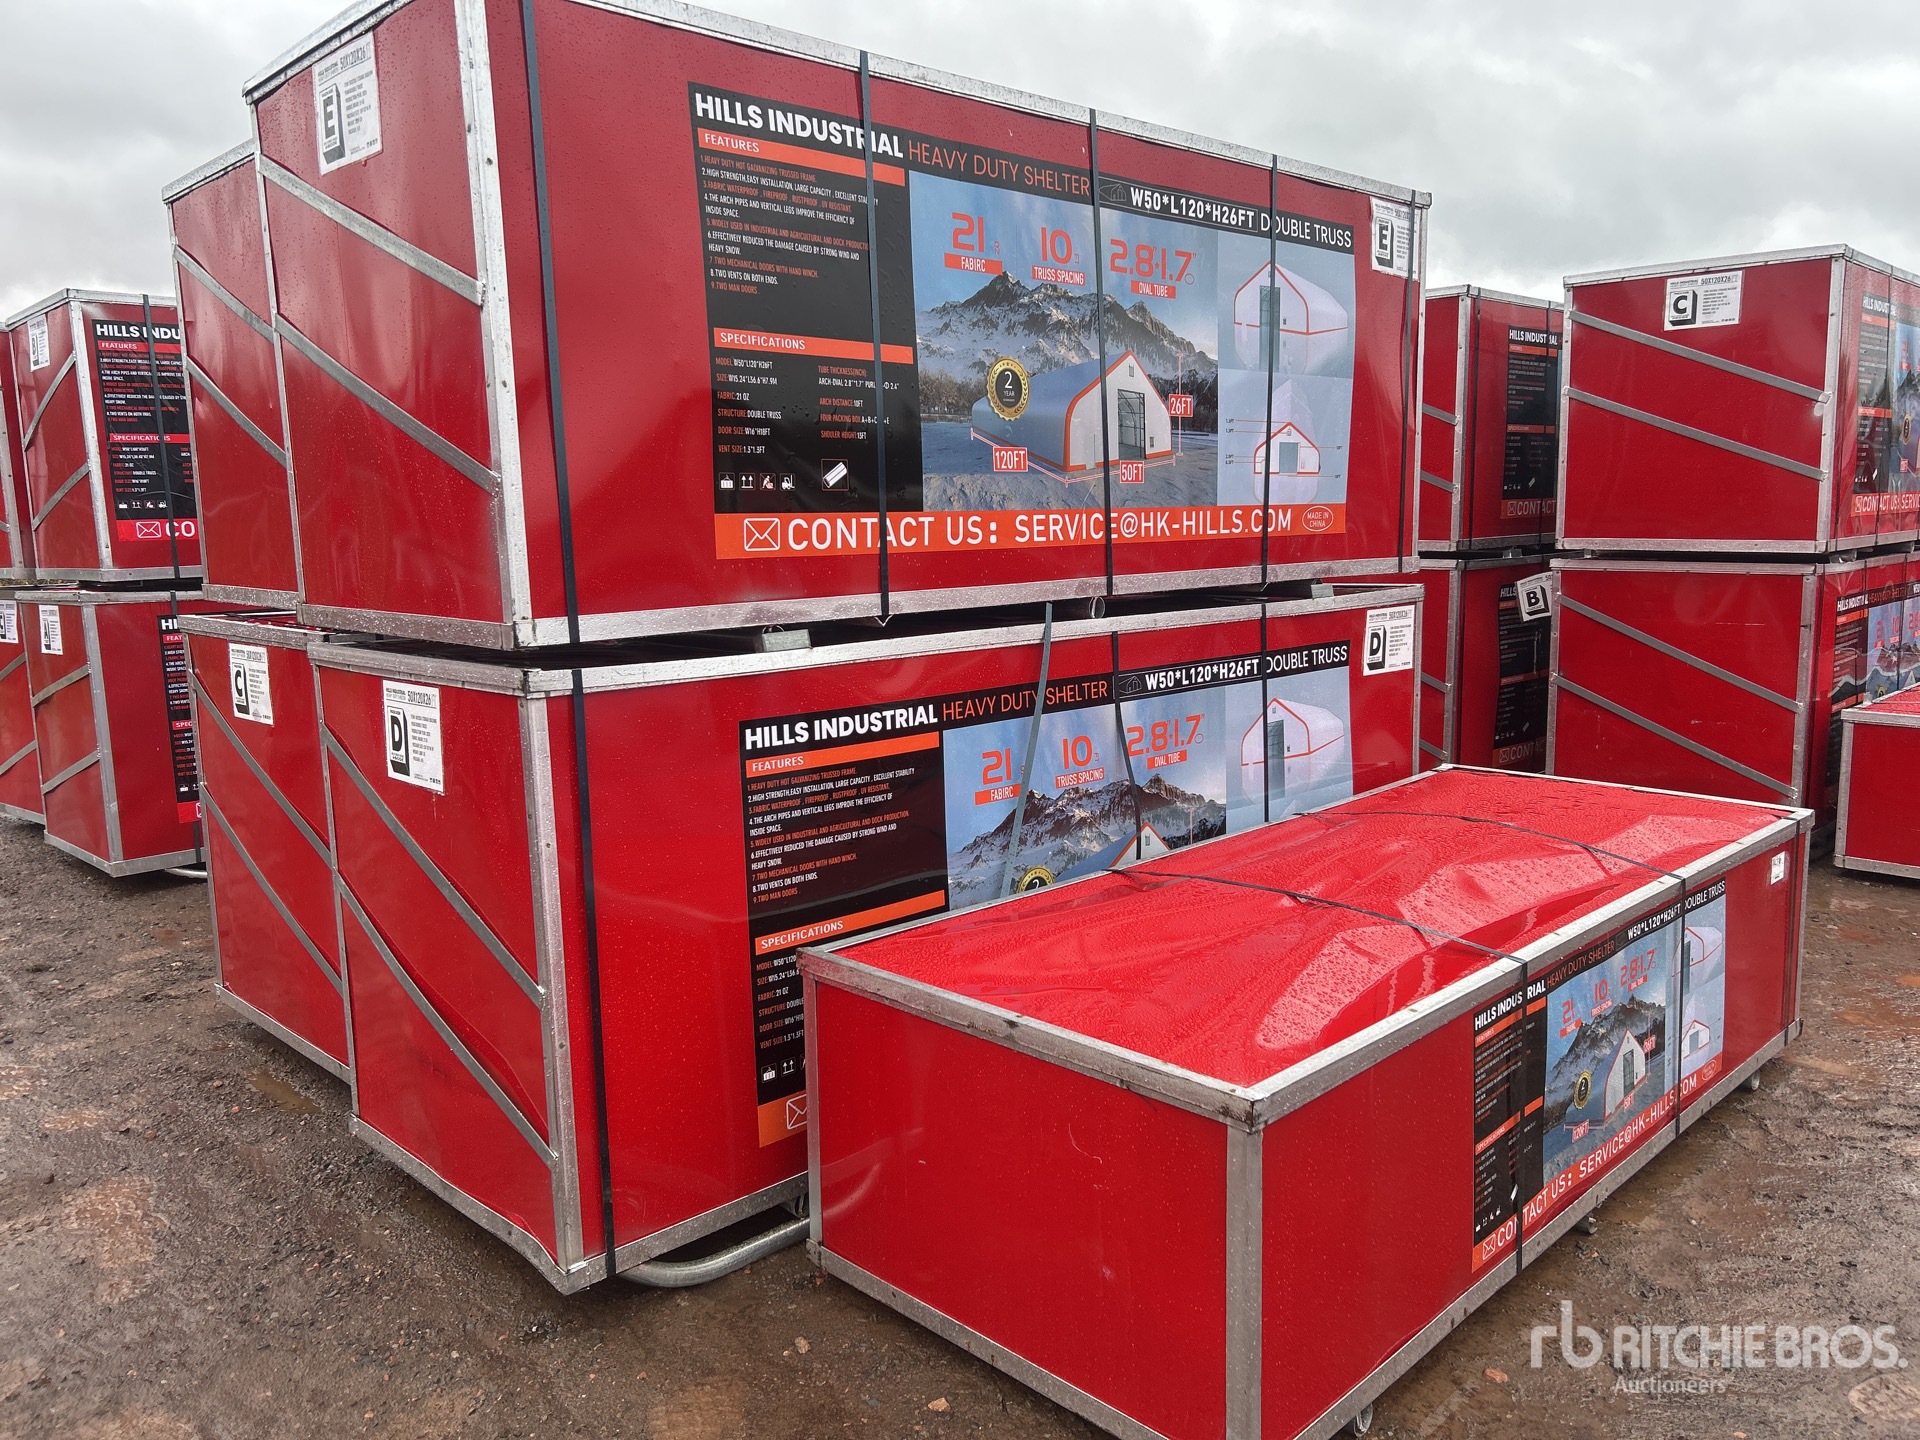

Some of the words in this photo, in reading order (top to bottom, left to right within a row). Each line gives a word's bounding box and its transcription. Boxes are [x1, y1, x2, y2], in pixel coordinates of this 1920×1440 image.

[323, 95, 336, 140] E
[704, 132, 760, 153] FEATURES
[695, 92, 764, 130] HILLS
[768, 108, 904, 159] INDUSTRIAL
[908, 140, 968, 171] HEAVY
[974, 154, 1018, 182] DUTY
[1024, 166, 1090, 196] SHELTER
[1314, 224, 1352, 248] TRUSS
[701, 165, 718, 177] 2.HIGH
[794, 183, 808, 193] LARGE
[834, 190, 856, 202] EXCELLENT
[703, 191, 718, 202] 4.THE
[719, 194, 733, 204] ARCH
[734, 197, 748, 207] PIPES
[749, 199, 759, 209] AND
[760, 201, 782, 213] VERTICAL
[783, 205, 794, 215] LEGS
[795, 207, 815, 218] IMPROVE
[815, 210, 824, 220] THE
[825, 212, 848, 224] EFFICIENCY
[705, 204, 721, 215] INSIDE
[952, 212, 985, 252] 21
[1378, 224, 1388, 251] E
[708, 242, 723, 252] HEAVY
[742, 235, 764, 246] REDUCED
[765, 238, 774, 247] THE
[774, 240, 794, 250] DAMAGE
[794, 243, 812, 253] CAUSED
[820, 247, 837, 256] STRONG
[838, 249, 849, 258] WIND
[850, 251, 859, 260] AND
[1041, 227, 1072, 264] 10
[709, 267, 726, 278] 8.TWO
[727, 270, 742, 280] VENTS
[751, 273, 764, 282] BOTH
[961, 257, 986, 272] FABIRC
[1034, 266, 1056, 282] TRUSS
[1057, 270, 1084, 284] SPACING
[1138, 282, 1152, 296] OVAL
[1154, 284, 1168, 298] TUBE
[1673, 295, 1688, 314] C
[96, 324, 140, 338] HILLS
[720, 332, 806, 350] SPECIFICATIONS
[1509, 329, 1524, 341] HILLS
[102, 342, 137, 350] FEATURES
[1004, 371, 1013, 388] 2
[1003, 390, 1015, 398] YEAR
[765, 410, 781, 419] TRUSS
[1170, 396, 1192, 416] 26FT
[995, 449, 1026, 470] 120FT
[1121, 464, 1144, 480] 50FT
[1306, 512, 1322, 520] MADE
[1322, 512, 1329, 520] IN
[1309, 519, 1326, 528] CHINA
[788, 516, 934, 550] CONTACT
[946, 515, 997, 545] US:
[1014, 508, 1292, 544] SERVICE@HK-HILLS.COM
[1526, 591, 1540, 607] B
[1369, 632, 1381, 656] D
[234, 670, 243, 697] C
[745, 721, 809, 750] HILLS
[814, 704, 938, 740] INDUSTRIAL
[943, 696, 996, 721] HEAVY
[1001, 688, 1038, 712] DUTY
[1046, 680, 1108, 706] SHELTER
[1312, 646, 1348, 668] TRUSS
[390, 715, 402, 752] D
[1063, 736, 1092, 769] 10
[1154, 755, 1170, 767] OVAL
[1170, 752, 1180, 764] TUBE
[752, 756, 804, 772] FEATURES
[982, 748, 1012, 785] 21
[747, 792, 763, 803] 2.HIGH
[835, 778, 848, 787] LARGE
[873, 770, 894, 781] EXCELLENT
[1057, 774, 1077, 788] TRUSS
[1078, 768, 1104, 784] SPACING
[990, 787, 1014, 801] FABIRC
[748, 816, 762, 826] 4.THE
[763, 813, 776, 823] ARCH
[777, 810, 790, 820] PIPES
[791, 809, 800, 818] AND
[802, 804, 822, 816] VERTICAL
[824, 802, 834, 812] LEGS
[835, 799, 854, 809] IMPROVE
[854, 797, 863, 806] THE
[863, 793, 886, 804] EFFICIENCY
[749, 826, 765, 836] INSIDE
[783, 841, 804, 852] REDUCED
[805, 839, 813, 848] THE
[814, 835, 833, 846] DAMAGE
[834, 832, 851, 842] CAUSED
[859, 827, 875, 837] STRONG
[876, 824, 887, 833] WIND
[887, 822, 896, 831] AND
[751, 860, 766, 870] HEAVY
[752, 882, 768, 892] 8.TWO
[769, 879, 783, 889] VENTS
[792, 874, 804, 884] BOTH
[761, 920, 843, 948] SPECIFICATIONS
[1475, 1006, 1496, 1030] HILLS
[1498, 979, 1546, 1016] INDUSRIAL
[1547, 968, 1568, 989] HEAVY
[1568, 956, 1587, 974] DUTY
[1588, 940, 1614, 964] SHELTER
[1708, 880, 1726, 899] TRUSS
[1595, 979, 1608, 1002] 10
[1562, 998, 1575, 1024] 21
[1581, 1080, 1586, 1091] 2
[1551, 1173, 1572, 1198] US:
